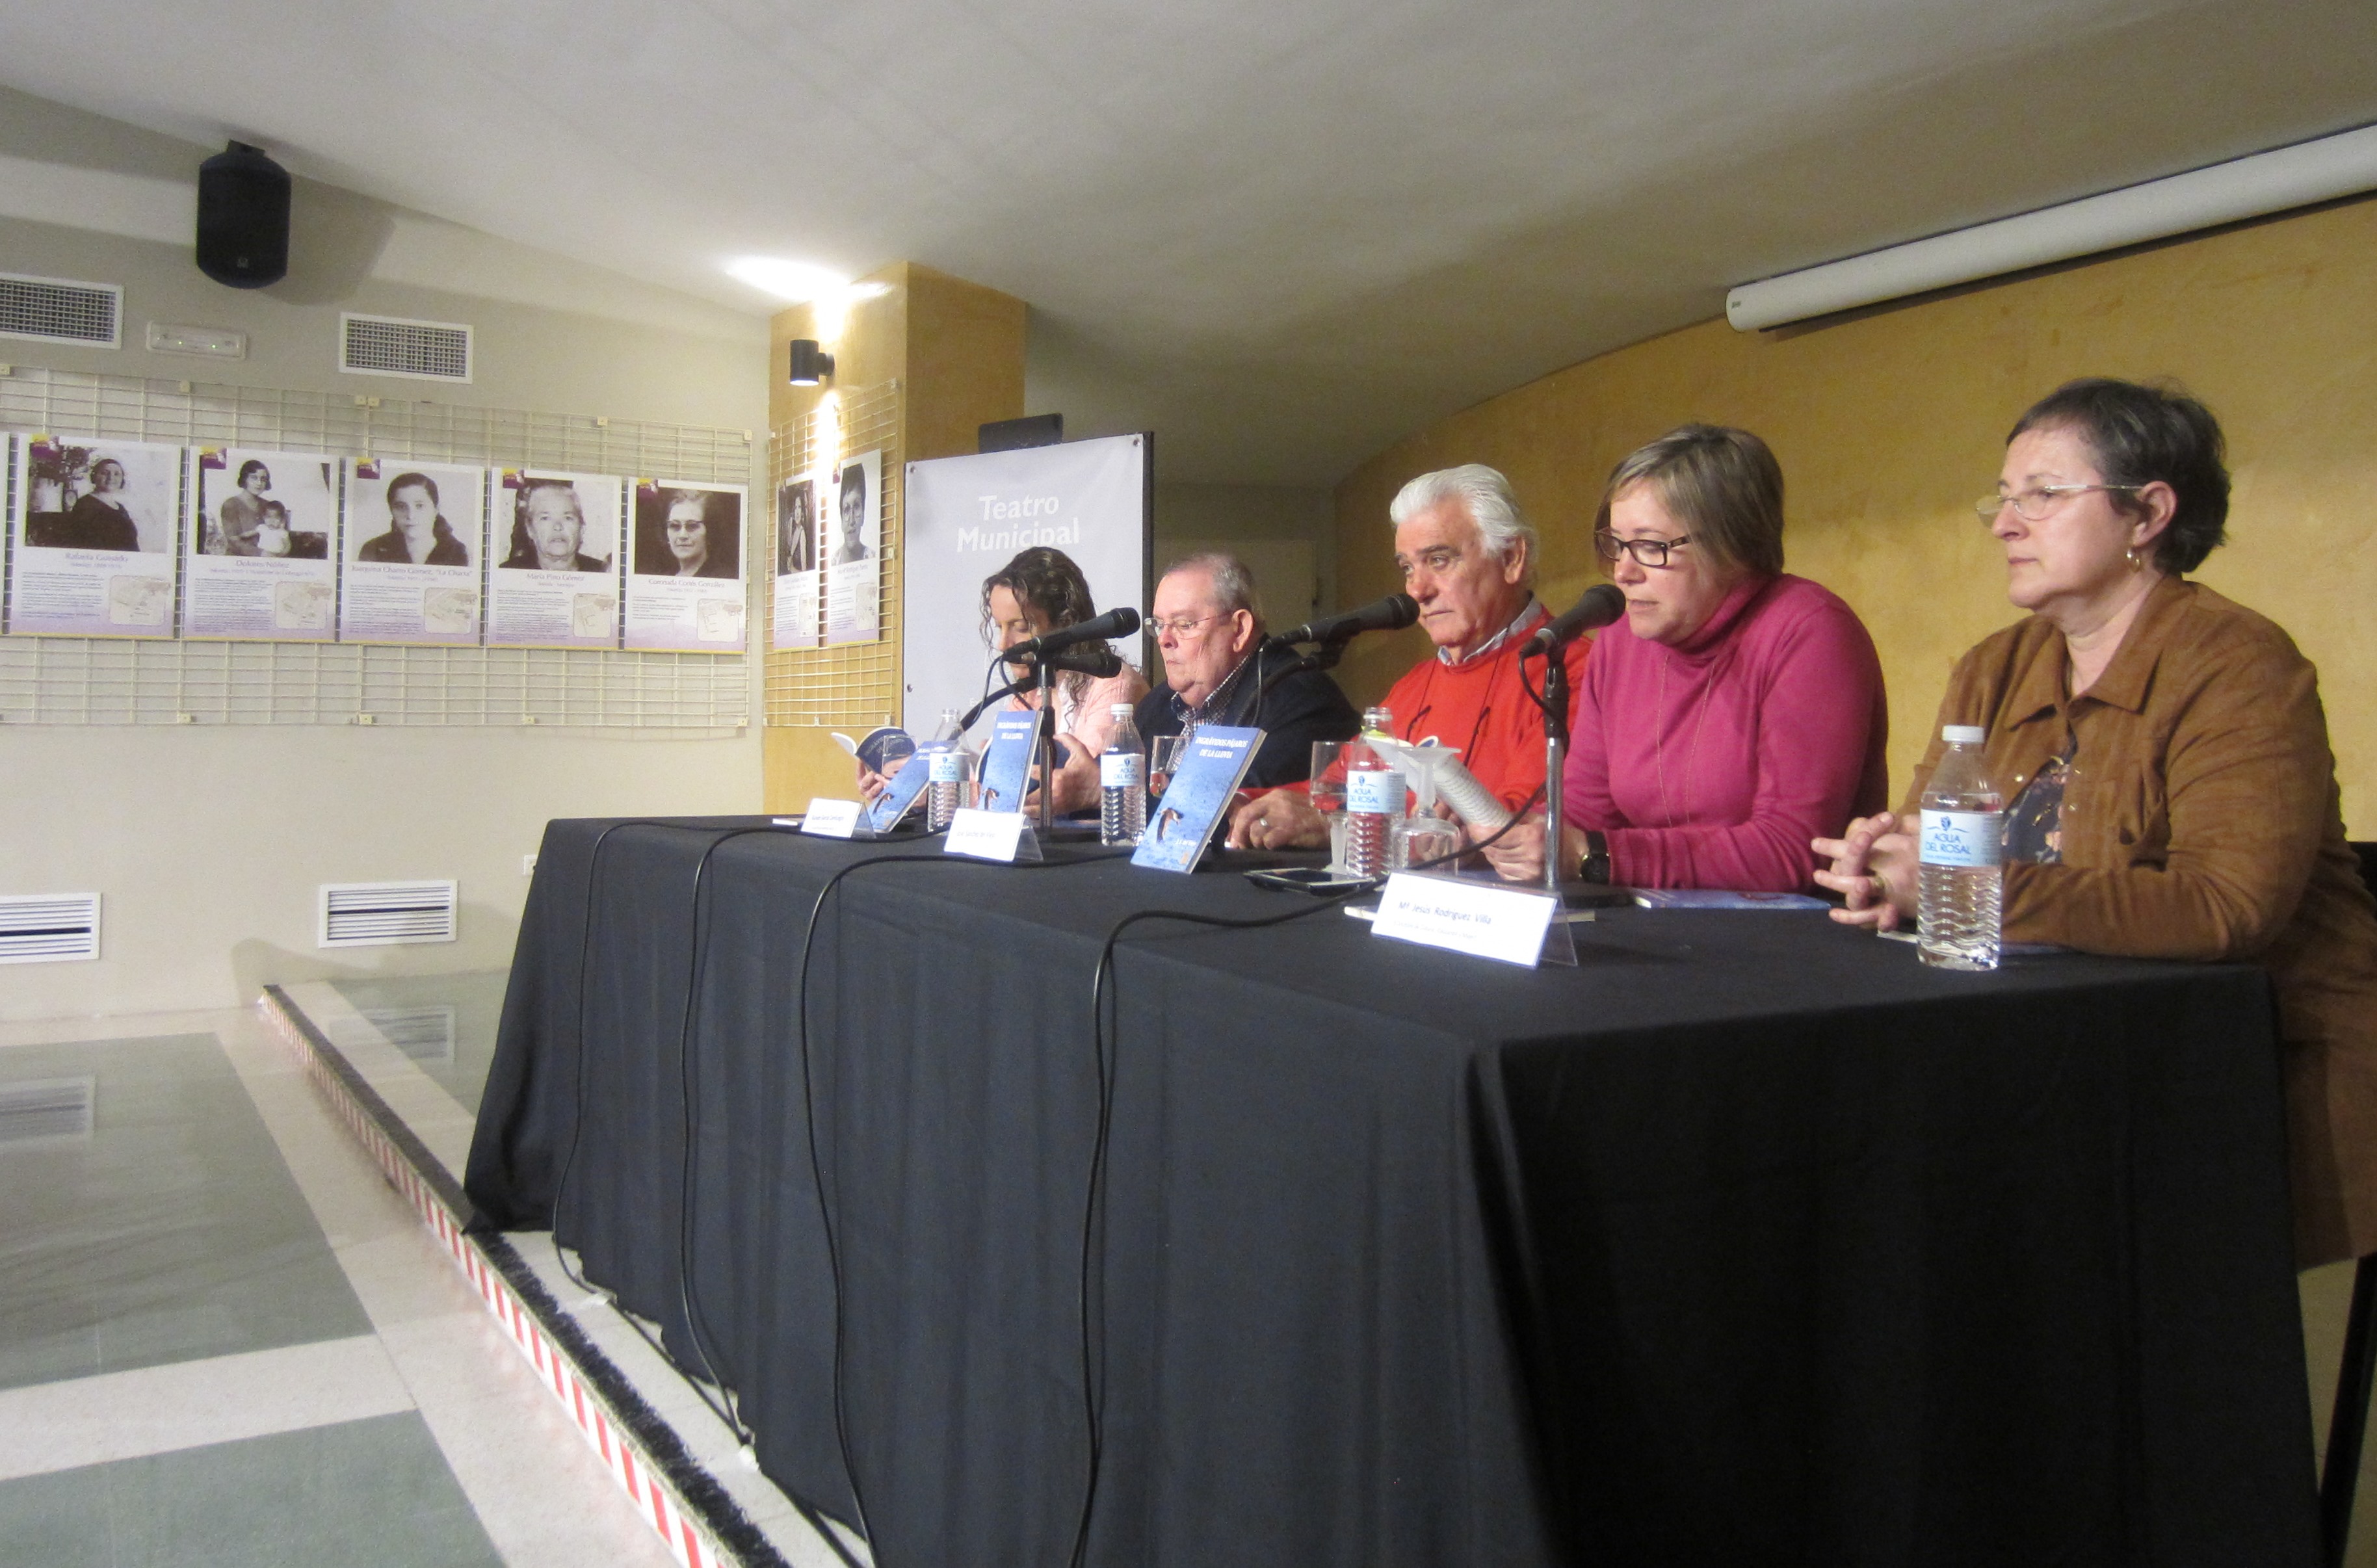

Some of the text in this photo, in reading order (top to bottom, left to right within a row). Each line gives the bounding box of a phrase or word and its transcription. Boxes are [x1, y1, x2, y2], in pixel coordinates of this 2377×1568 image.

[978, 494, 1059, 521] Teatro
[957, 517, 1081, 553] Municipal
[1199, 748, 1208, 757] DE
[1925, 841, 1972, 855] DEL ROSAL
